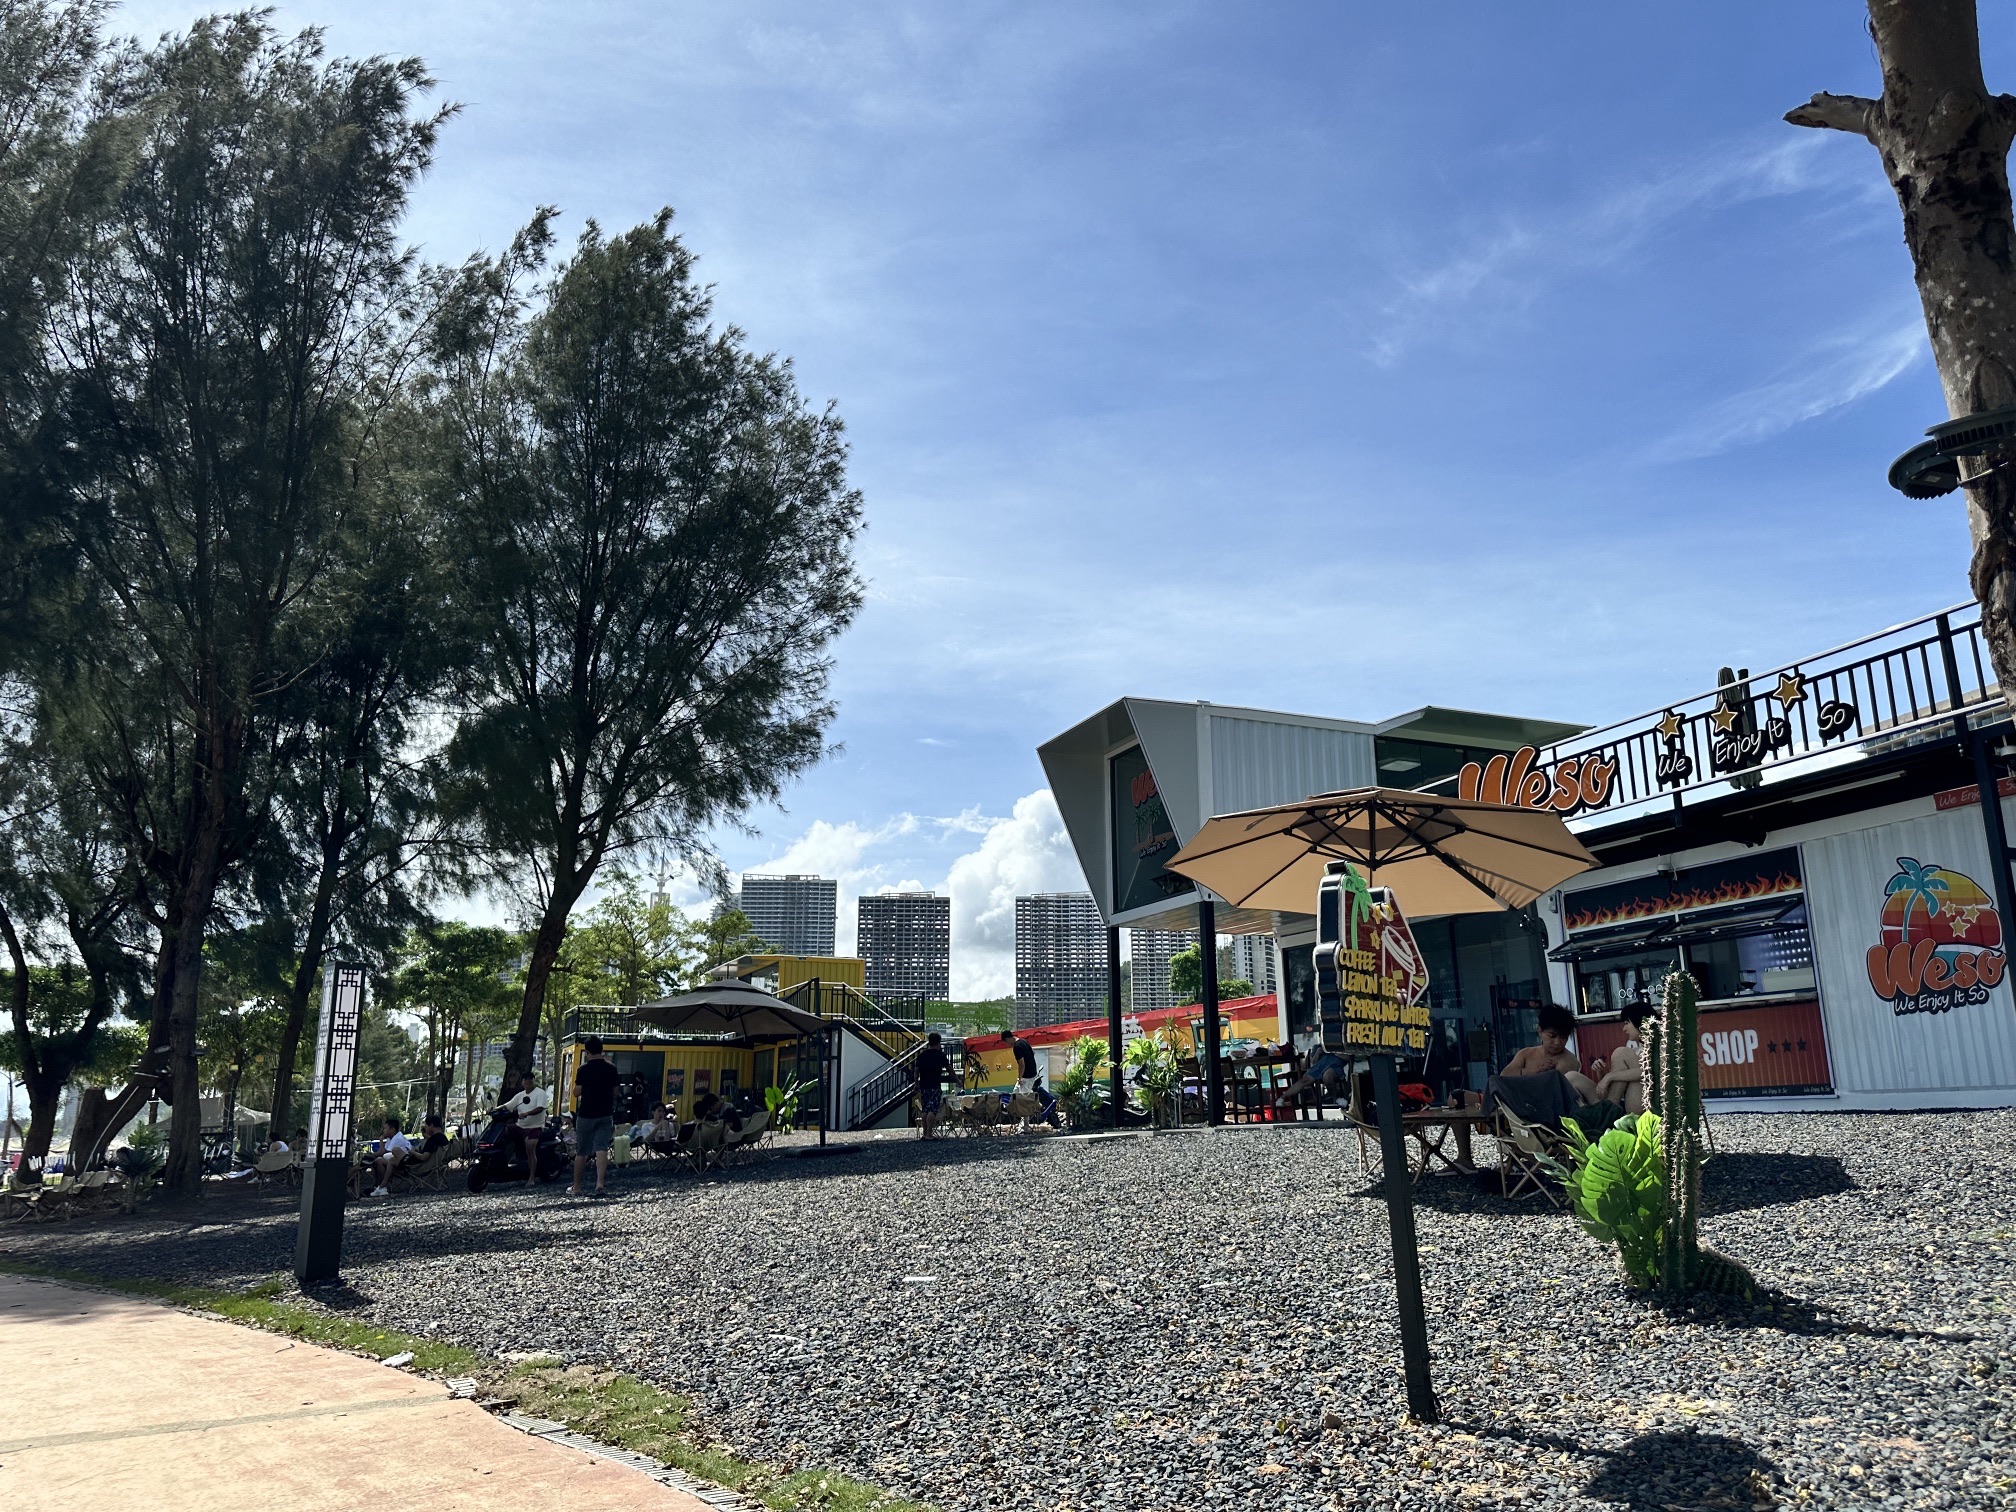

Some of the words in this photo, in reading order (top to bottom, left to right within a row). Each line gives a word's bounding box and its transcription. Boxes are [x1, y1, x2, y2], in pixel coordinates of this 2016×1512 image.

[1657, 755, 1687, 777] We
[1715, 732, 1762, 764] Enjoy
[1767, 720, 1784, 744] It
[1819, 704, 1845, 731] So
[1131, 767, 1160, 807] We
[1458, 745, 1615, 811] Weso
[1939, 793, 1957, 807] We
[1340, 948, 1377, 972] COFFEE
[1867, 938, 2007, 999] Weso
[1342, 970, 1378, 995] LEMON
[1379, 976, 1398, 999] TEA
[1895, 998, 1915, 1012] We
[1918, 992, 1950, 1010] Enjoy
[1954, 989, 1965, 1004] It
[1968, 986, 1986, 1002] So
[1344, 994, 1399, 1022] SPARKLING
[1400, 1004, 1431, 1027] WATER
[1346, 1022, 1380, 1045] FRESH
[1382, 1026, 1405, 1047] MILK
[1406, 1026, 1425, 1049] TEA
[1701, 1029, 1759, 1067] SHOP
